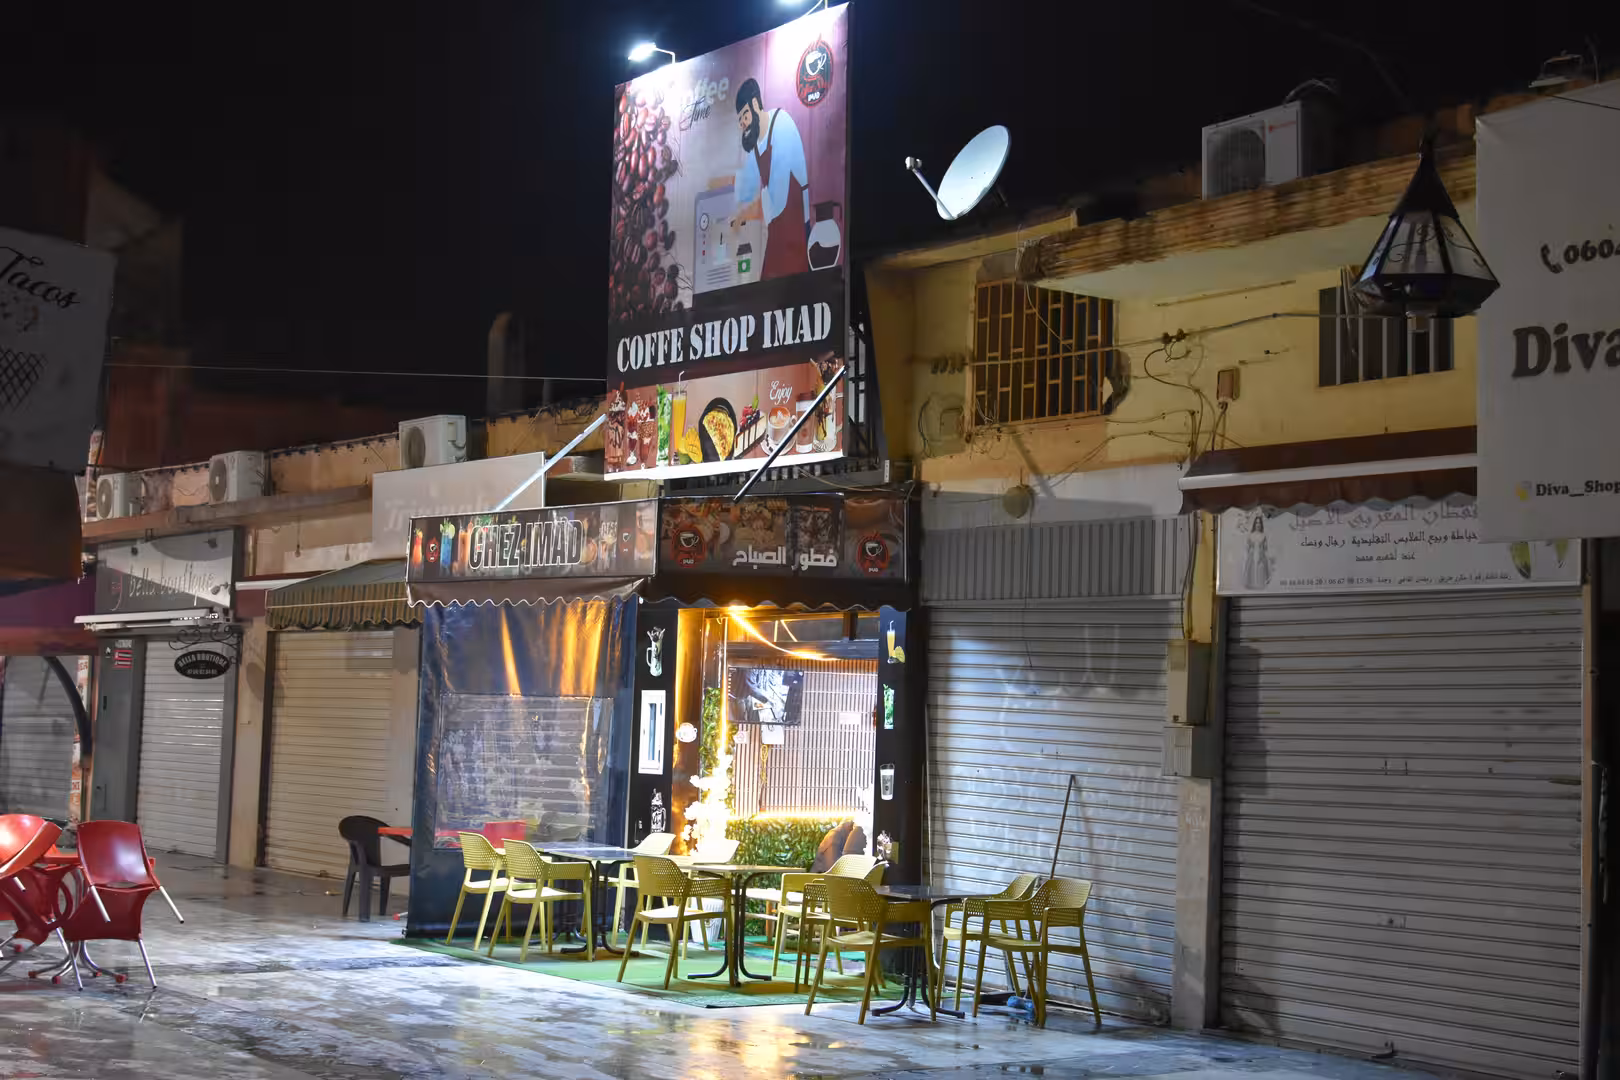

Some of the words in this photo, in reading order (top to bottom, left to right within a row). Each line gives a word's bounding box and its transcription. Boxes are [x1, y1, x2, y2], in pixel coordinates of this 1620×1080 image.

[674, 77, 729, 108] offee
[680, 96, 711, 131] Time
[1564, 239, 1620, 265] 060
[0, 247, 80, 309] Tacos
[617, 327, 684, 372] COFFE
[690, 315, 755, 361] SHOP
[763, 302, 832, 349] IMAD
[769, 380, 793, 406] Enjoy
[469, 523, 522, 570] CHEZ
[524, 519, 583, 568] IMAD
[1325, 536, 1346, 548] رجال
[732, 545, 787, 569] الصباح
[792, 547, 838, 571] فطور
[196, 653, 228, 669] BOUTIQUE
